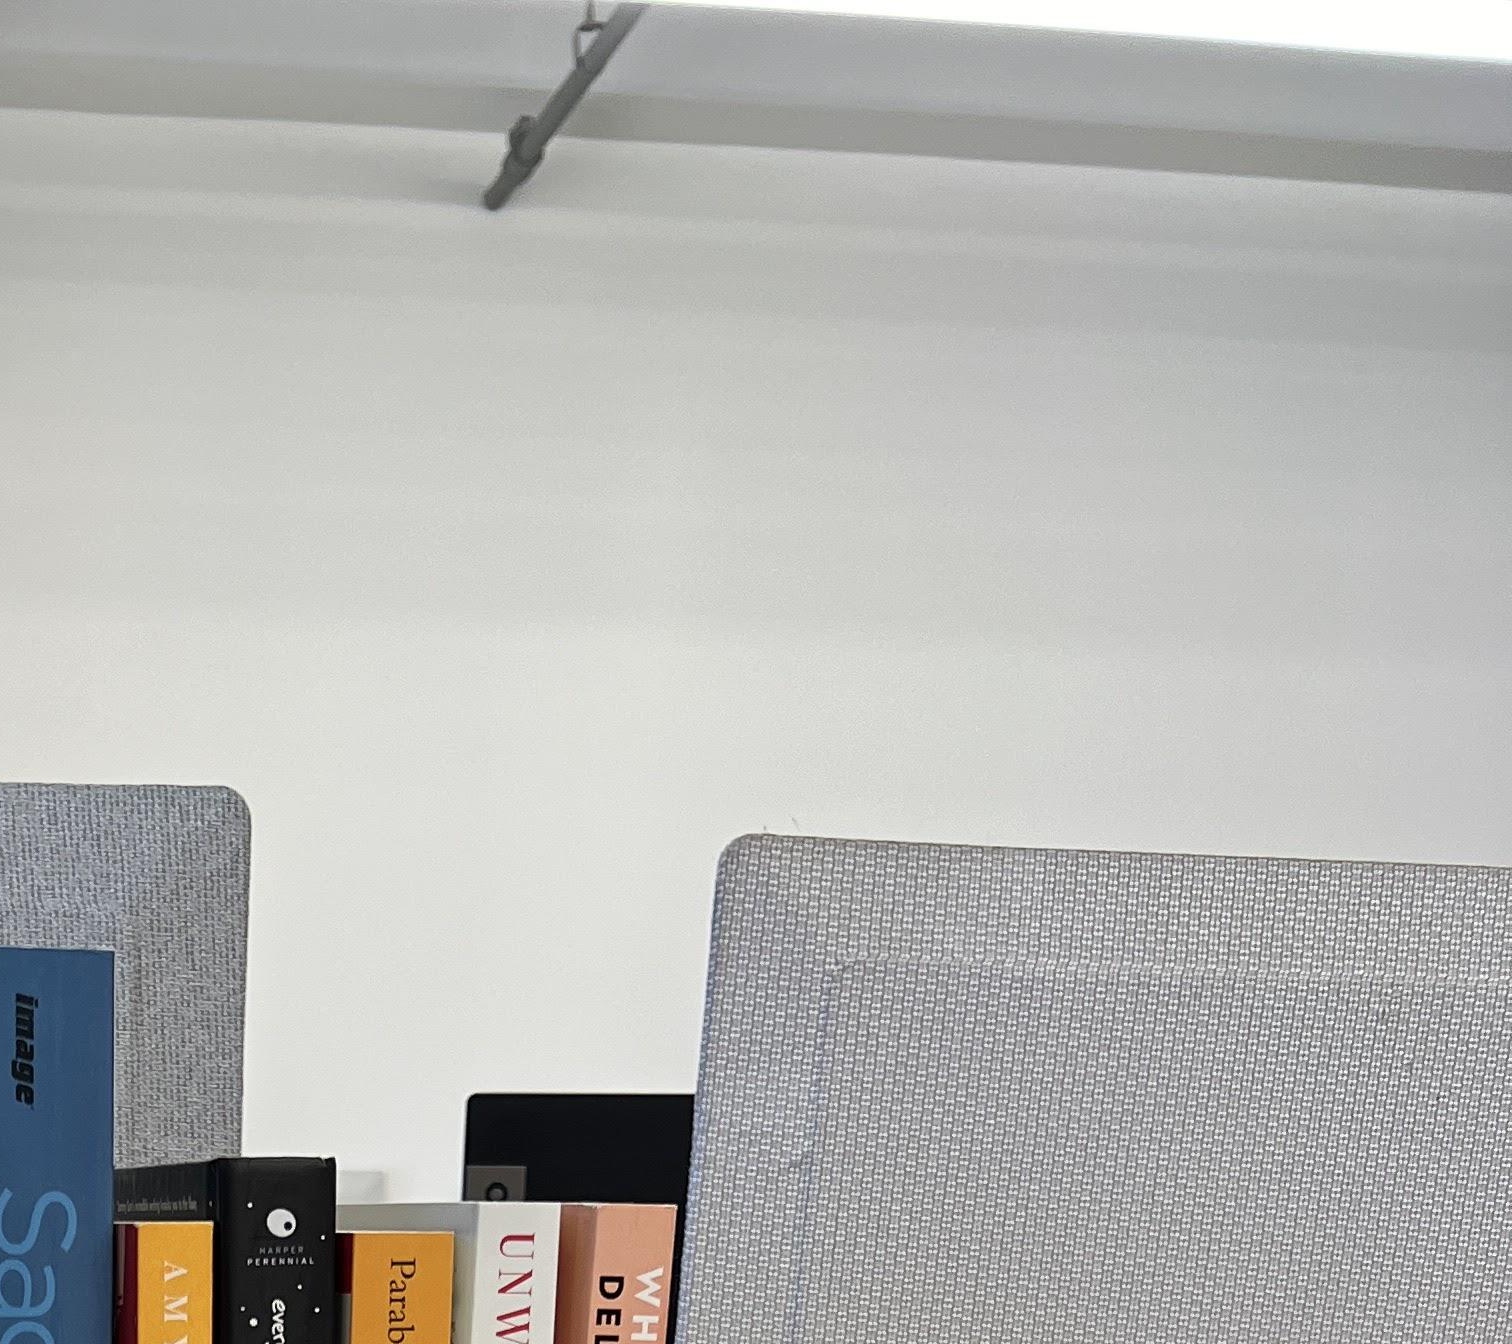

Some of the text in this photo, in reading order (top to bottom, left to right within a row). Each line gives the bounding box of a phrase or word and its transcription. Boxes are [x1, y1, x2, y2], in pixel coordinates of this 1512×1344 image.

[11, 991, 41, 1109] image
[258, 1246, 305, 1256] HARPER
[246, 1256, 316, 1267] PERENNIAL
